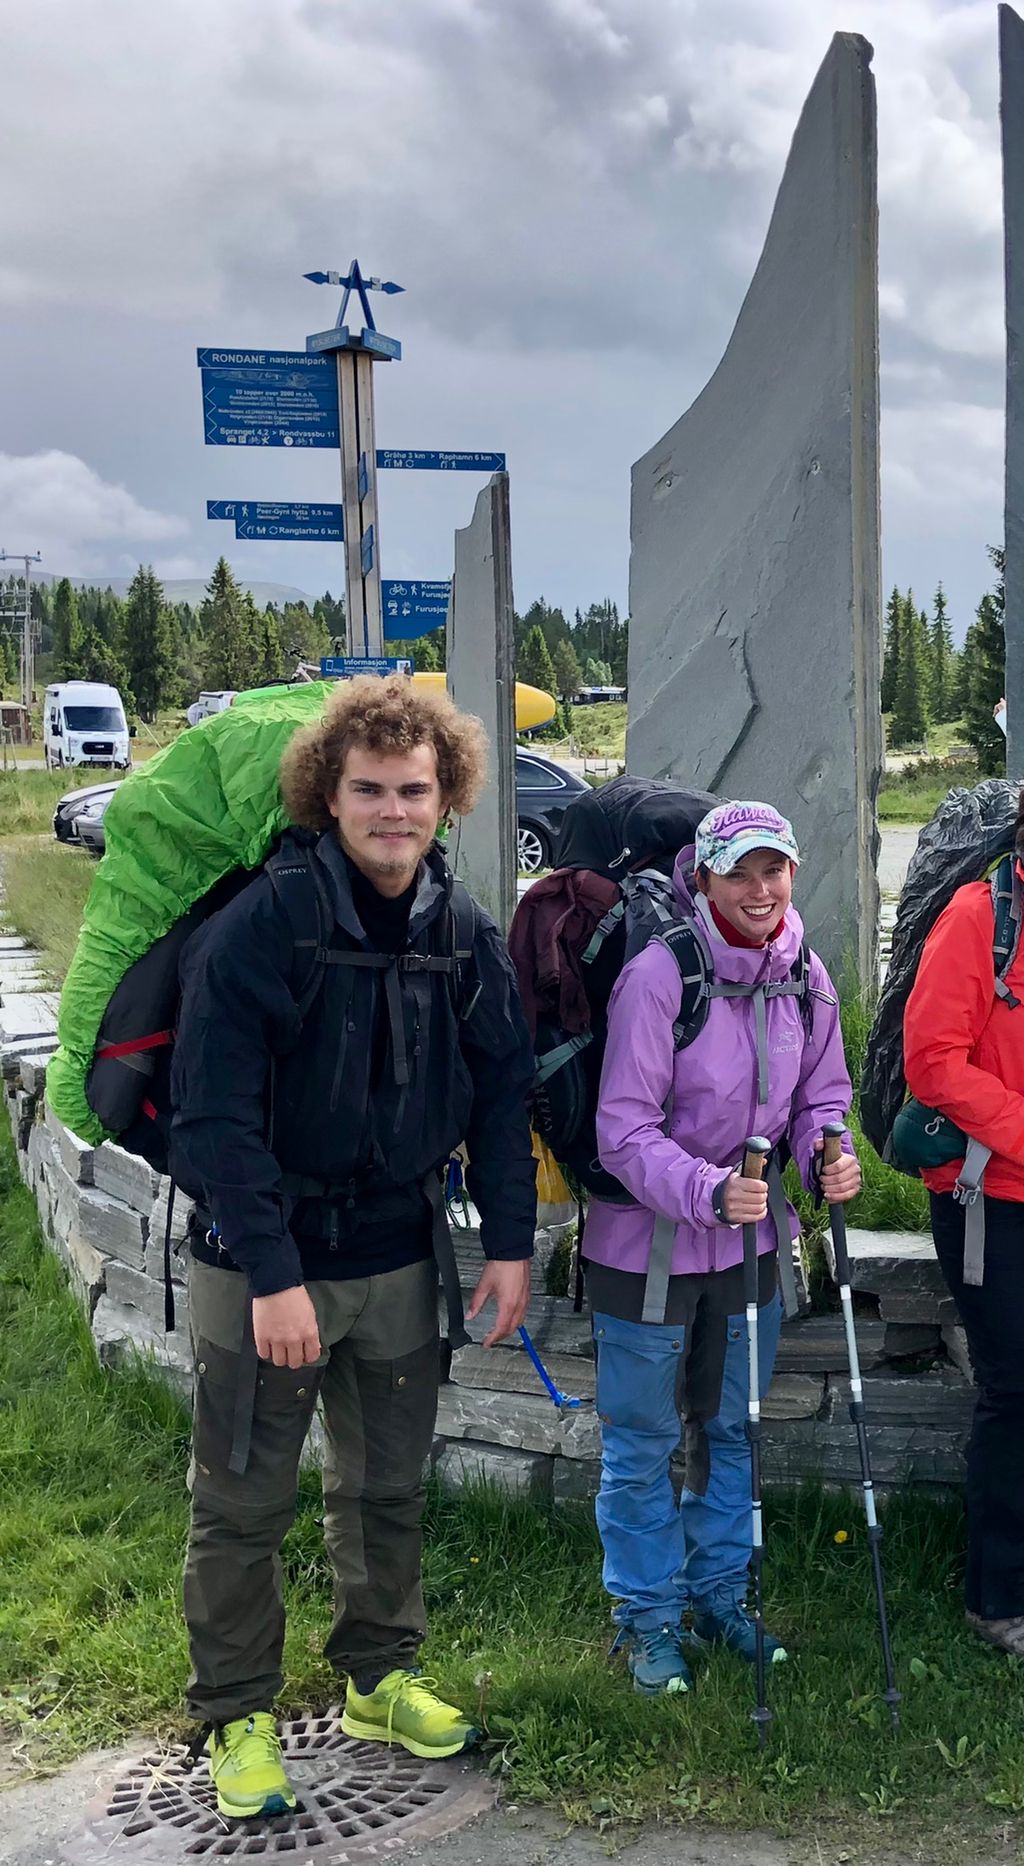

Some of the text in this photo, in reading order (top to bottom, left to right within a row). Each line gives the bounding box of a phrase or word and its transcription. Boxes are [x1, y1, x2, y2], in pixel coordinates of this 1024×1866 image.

[212, 353, 327, 366] RONDANE nasjonalpark
[344, 658, 388, 668] Informasjon
